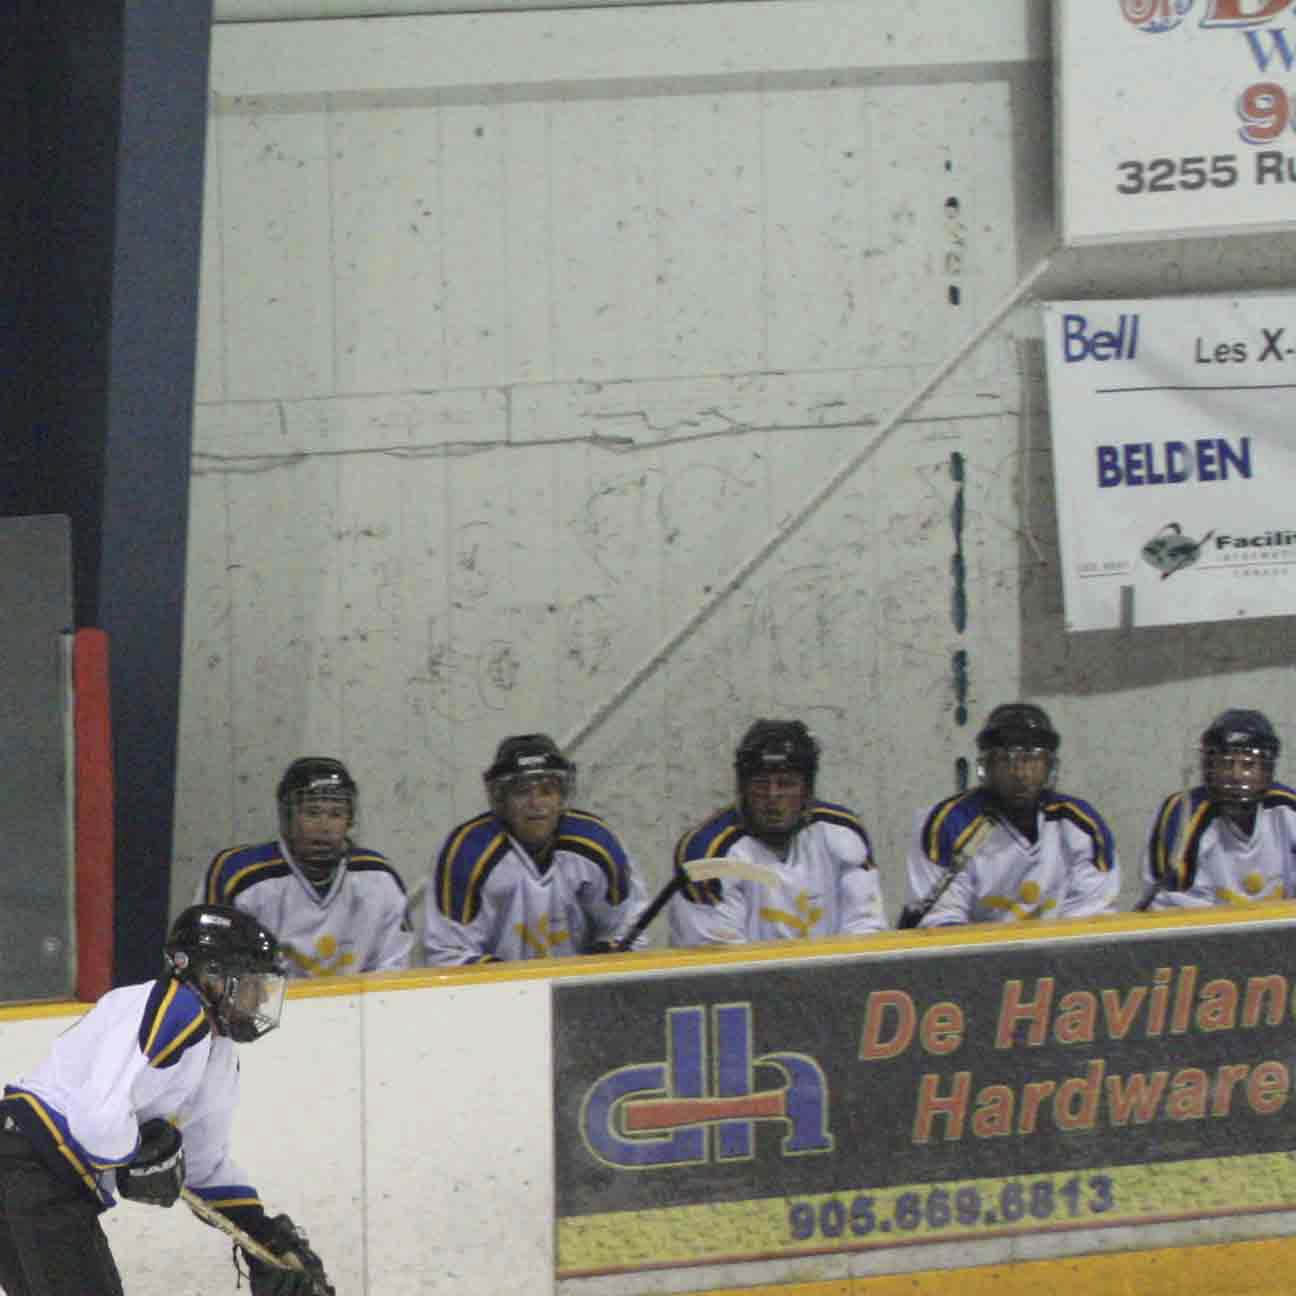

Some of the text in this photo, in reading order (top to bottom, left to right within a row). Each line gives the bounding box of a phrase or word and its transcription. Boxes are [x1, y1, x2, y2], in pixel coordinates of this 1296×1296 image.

[1116, 154, 1239, 195] 3255
[1062, 313, 1140, 363] Bell
[1195, 337, 1248, 364] Les
[1095, 437, 1253, 488] BELDEN
[860, 965, 1296, 1061] De Havilan
[911, 1060, 1291, 1144] Hardware
[788, 1176, 1116, 1241] 905.669.6813
